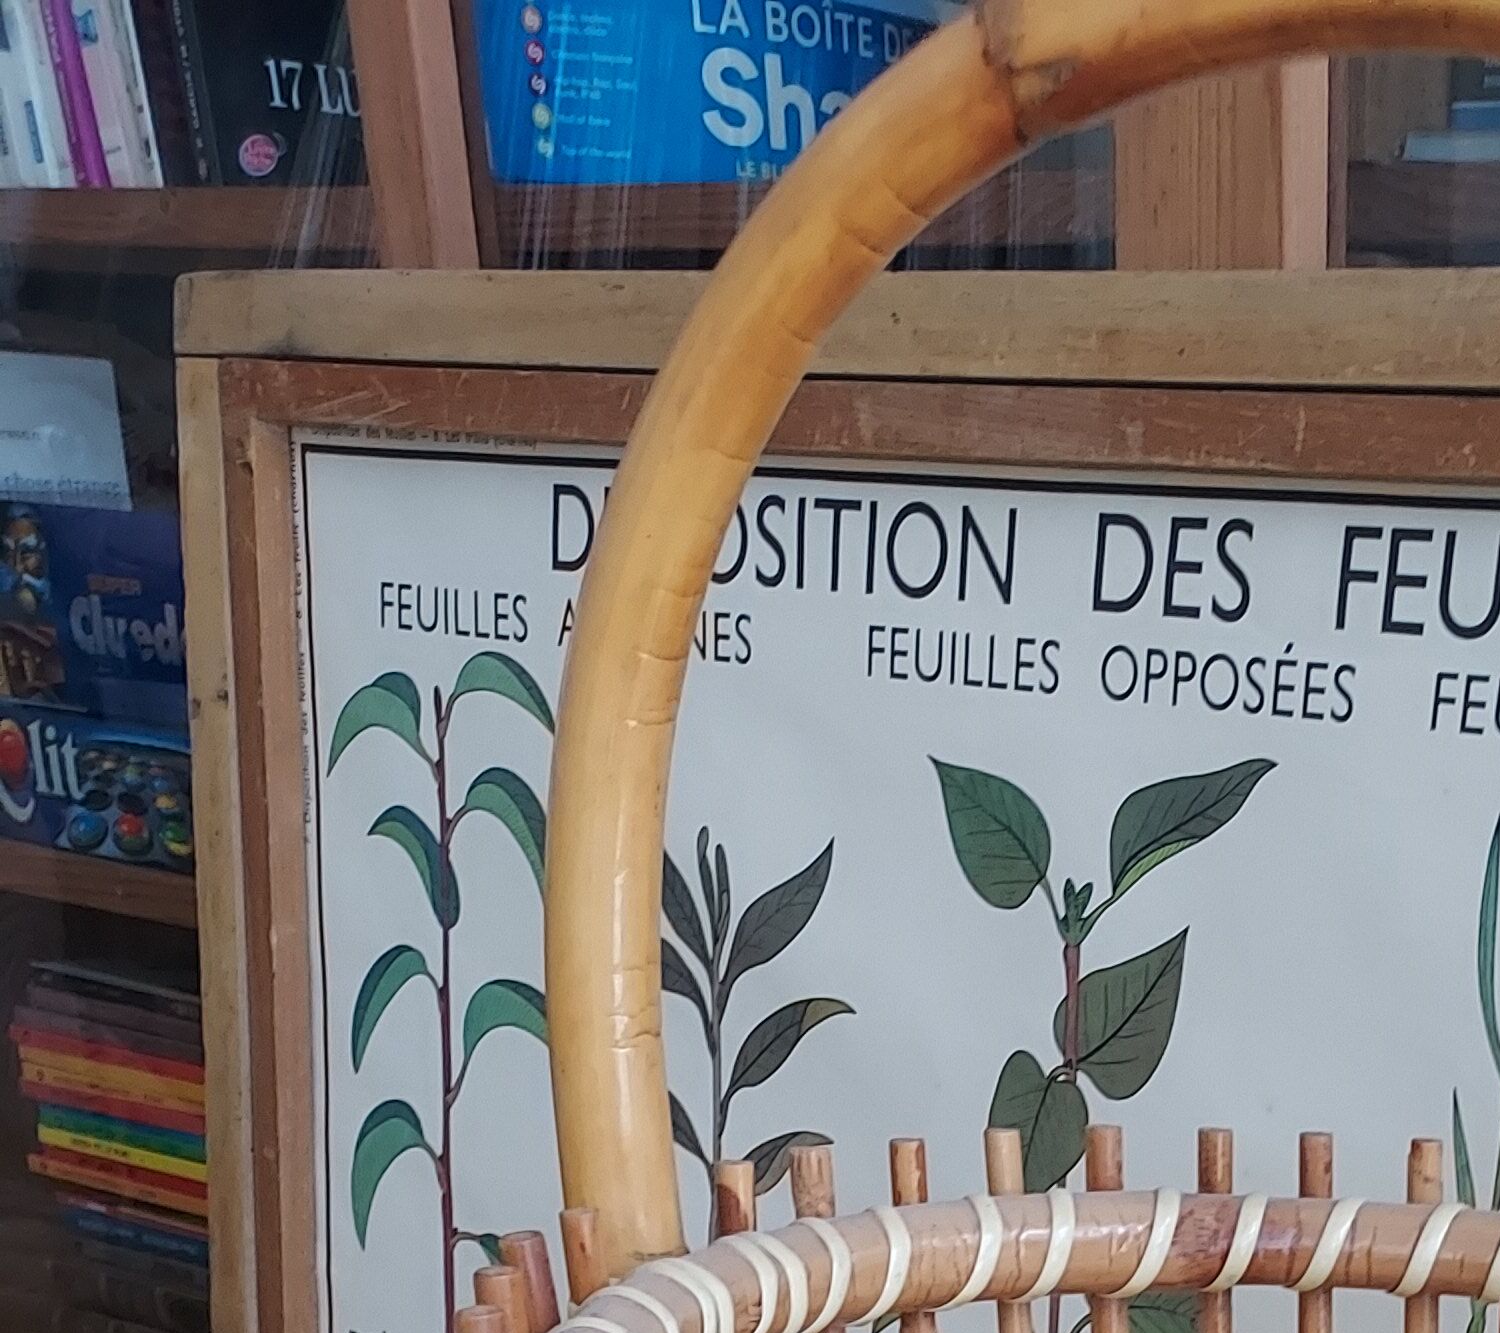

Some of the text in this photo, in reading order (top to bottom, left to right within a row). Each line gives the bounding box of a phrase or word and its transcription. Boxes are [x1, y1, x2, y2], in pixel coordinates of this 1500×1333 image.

[765, 0, 875, 58] BOÎTE
[263, 57, 303, 112] 17
[551, 483, 1018, 606] DSITION
[1091, 511, 1255, 623] DES
[379, 582, 752, 665] FEUILLES ANES
[867, 624, 1357, 725] FEUILLES OPPOSÉES
